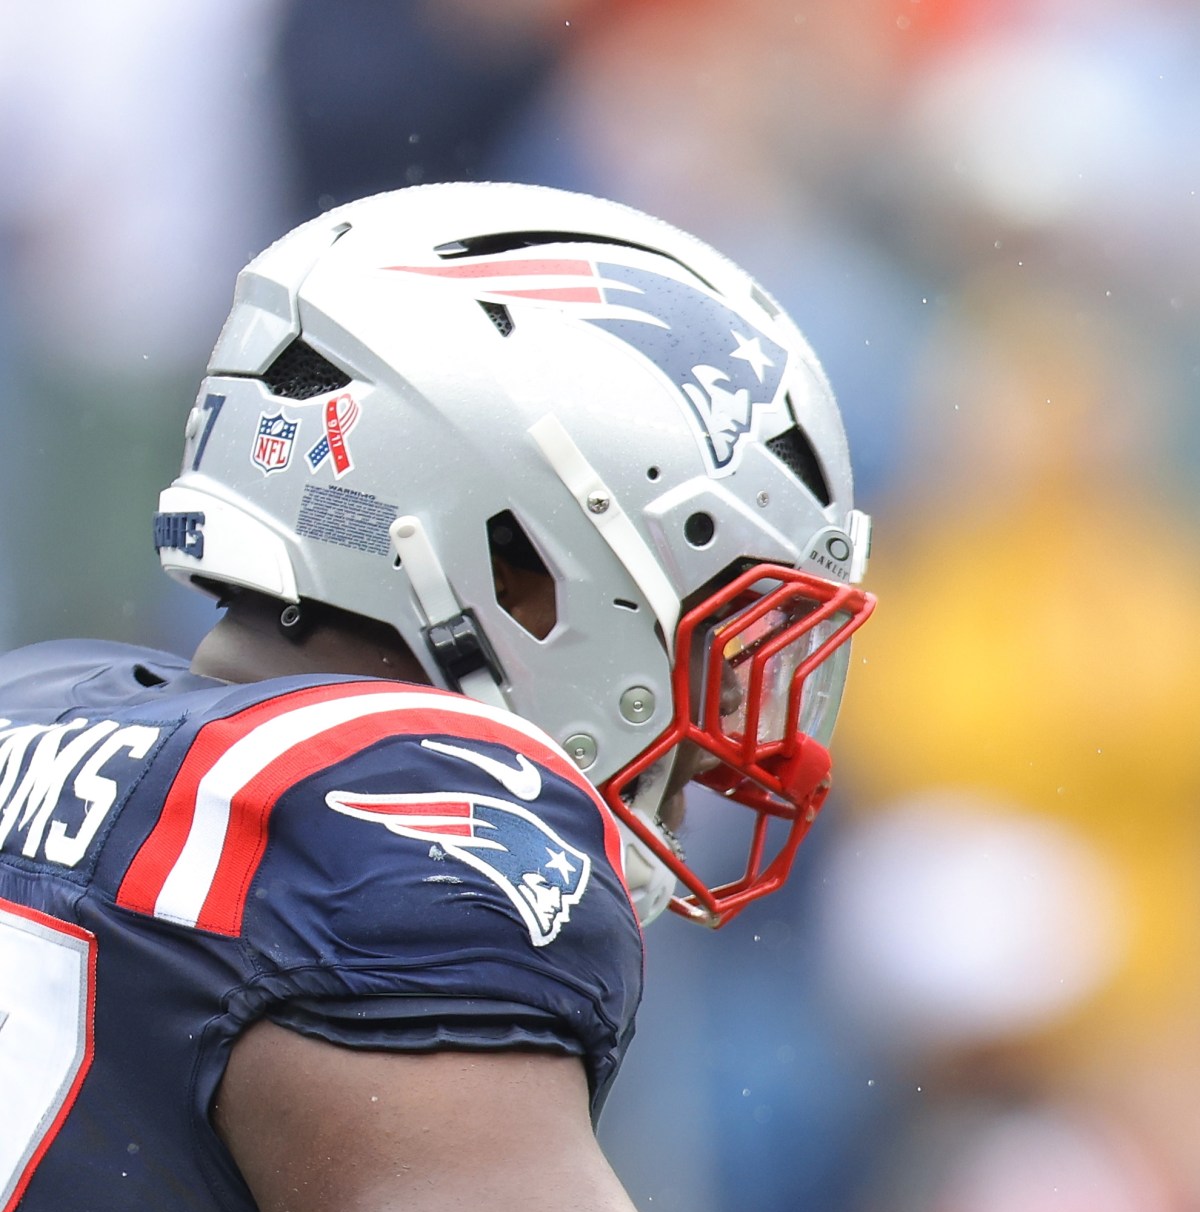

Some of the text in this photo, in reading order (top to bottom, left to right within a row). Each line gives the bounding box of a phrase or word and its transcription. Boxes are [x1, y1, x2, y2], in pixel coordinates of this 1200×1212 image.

[328, 419, 342, 448] 9/11
[256, 436, 286, 466] NFL
[328, 485, 376, 500] WARNING
[809, 550, 850, 580] OAKLEY
